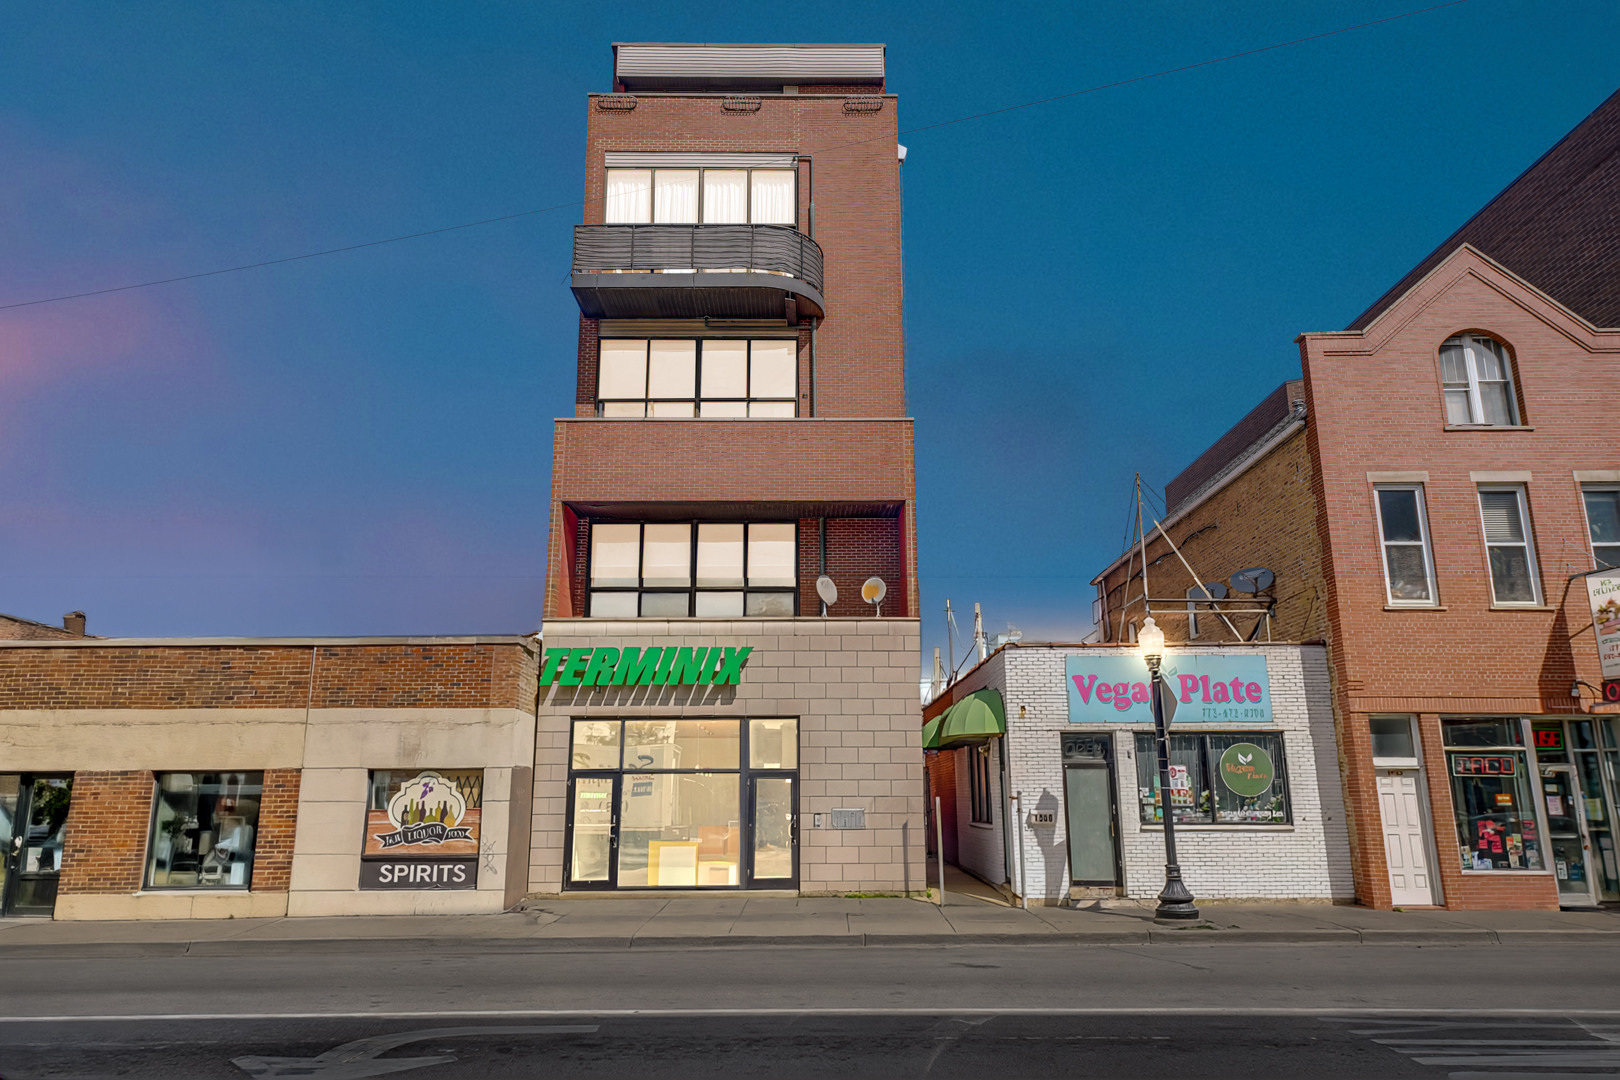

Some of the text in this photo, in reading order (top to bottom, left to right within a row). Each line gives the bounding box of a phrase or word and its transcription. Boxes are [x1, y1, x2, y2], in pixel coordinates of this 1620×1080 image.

[539, 647, 754, 686] TERMINIX
[1072, 674, 1263, 711] Vega Plate
[407, 825, 442, 841] LIQUOR
[379, 864, 466, 883] SPIRITS
